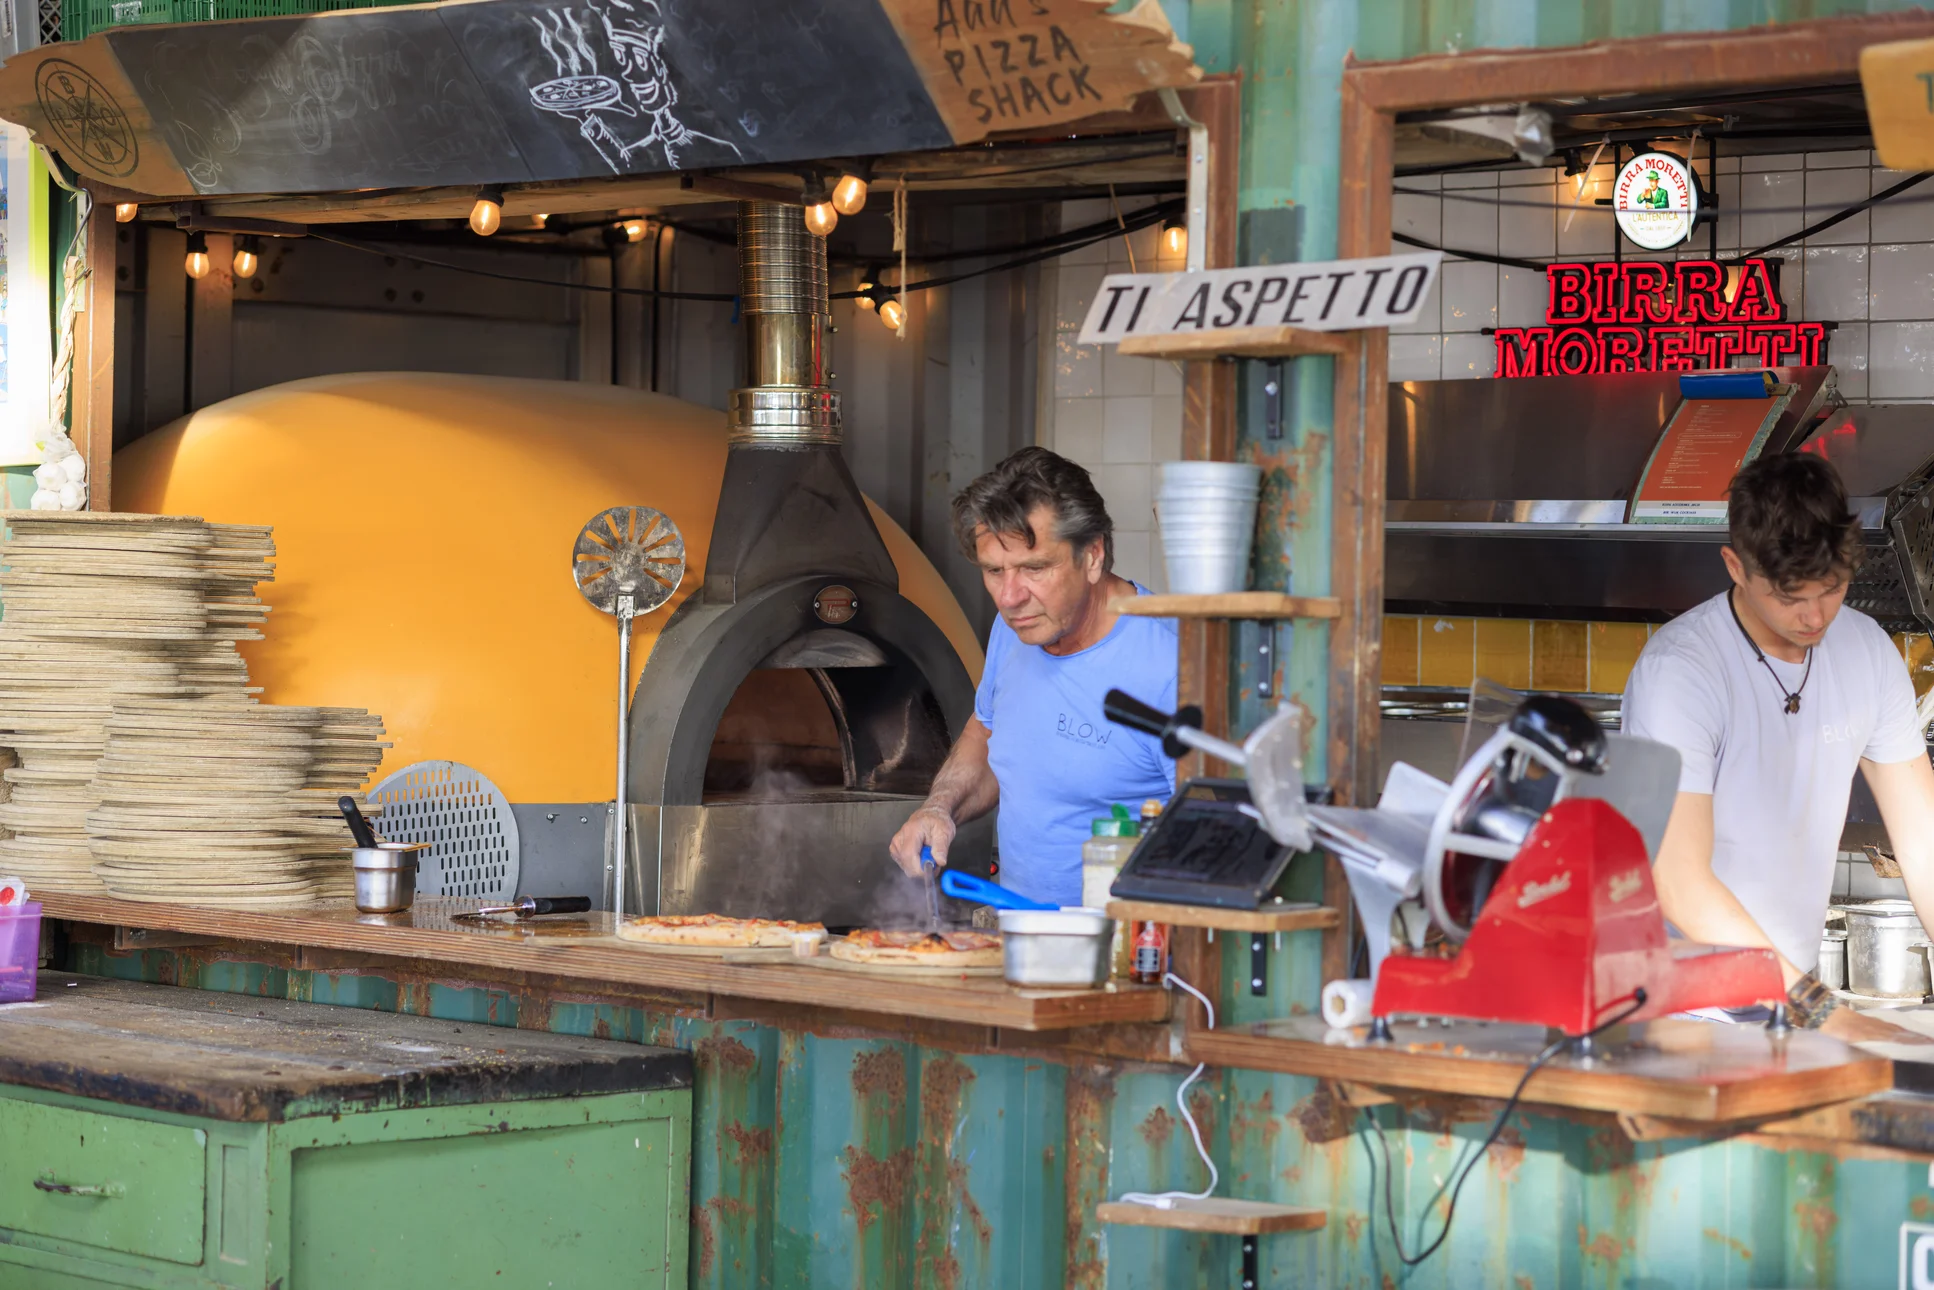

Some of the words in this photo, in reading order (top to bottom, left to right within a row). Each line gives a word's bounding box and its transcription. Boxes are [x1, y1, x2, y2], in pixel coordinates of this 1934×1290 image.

[943, 24, 1082, 87] PIZZA
[967, 63, 1102, 125] SHACK
[1619, 163, 1644, 212] BIRRA
[1645, 158, 1689, 208] MORETTI
[1097, 285, 1152, 334] TI
[1172, 265, 1430, 331] ASPETTO
[1545, 258, 1781, 325] BIRRA
[1493, 322, 1826, 378] MORETTI
[1057, 713, 1113, 744] BLOW
